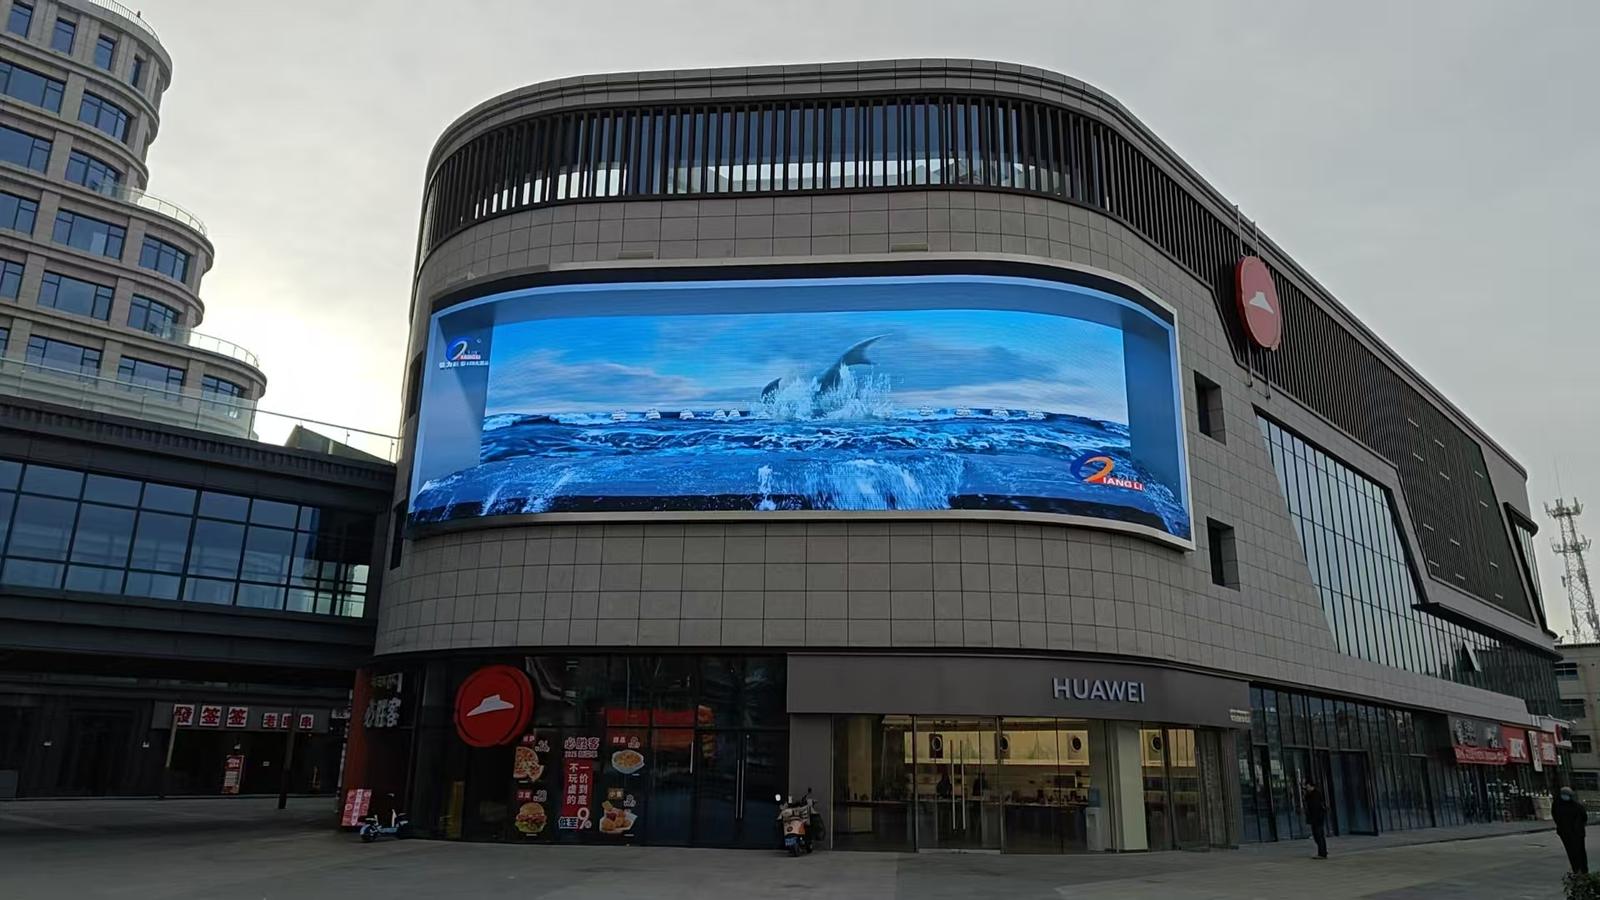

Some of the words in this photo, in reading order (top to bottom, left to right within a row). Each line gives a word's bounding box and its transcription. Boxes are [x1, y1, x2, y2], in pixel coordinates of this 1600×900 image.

[1052, 677, 1145, 703] HUAWEI
[564, 736, 600, 750] 必胜客
